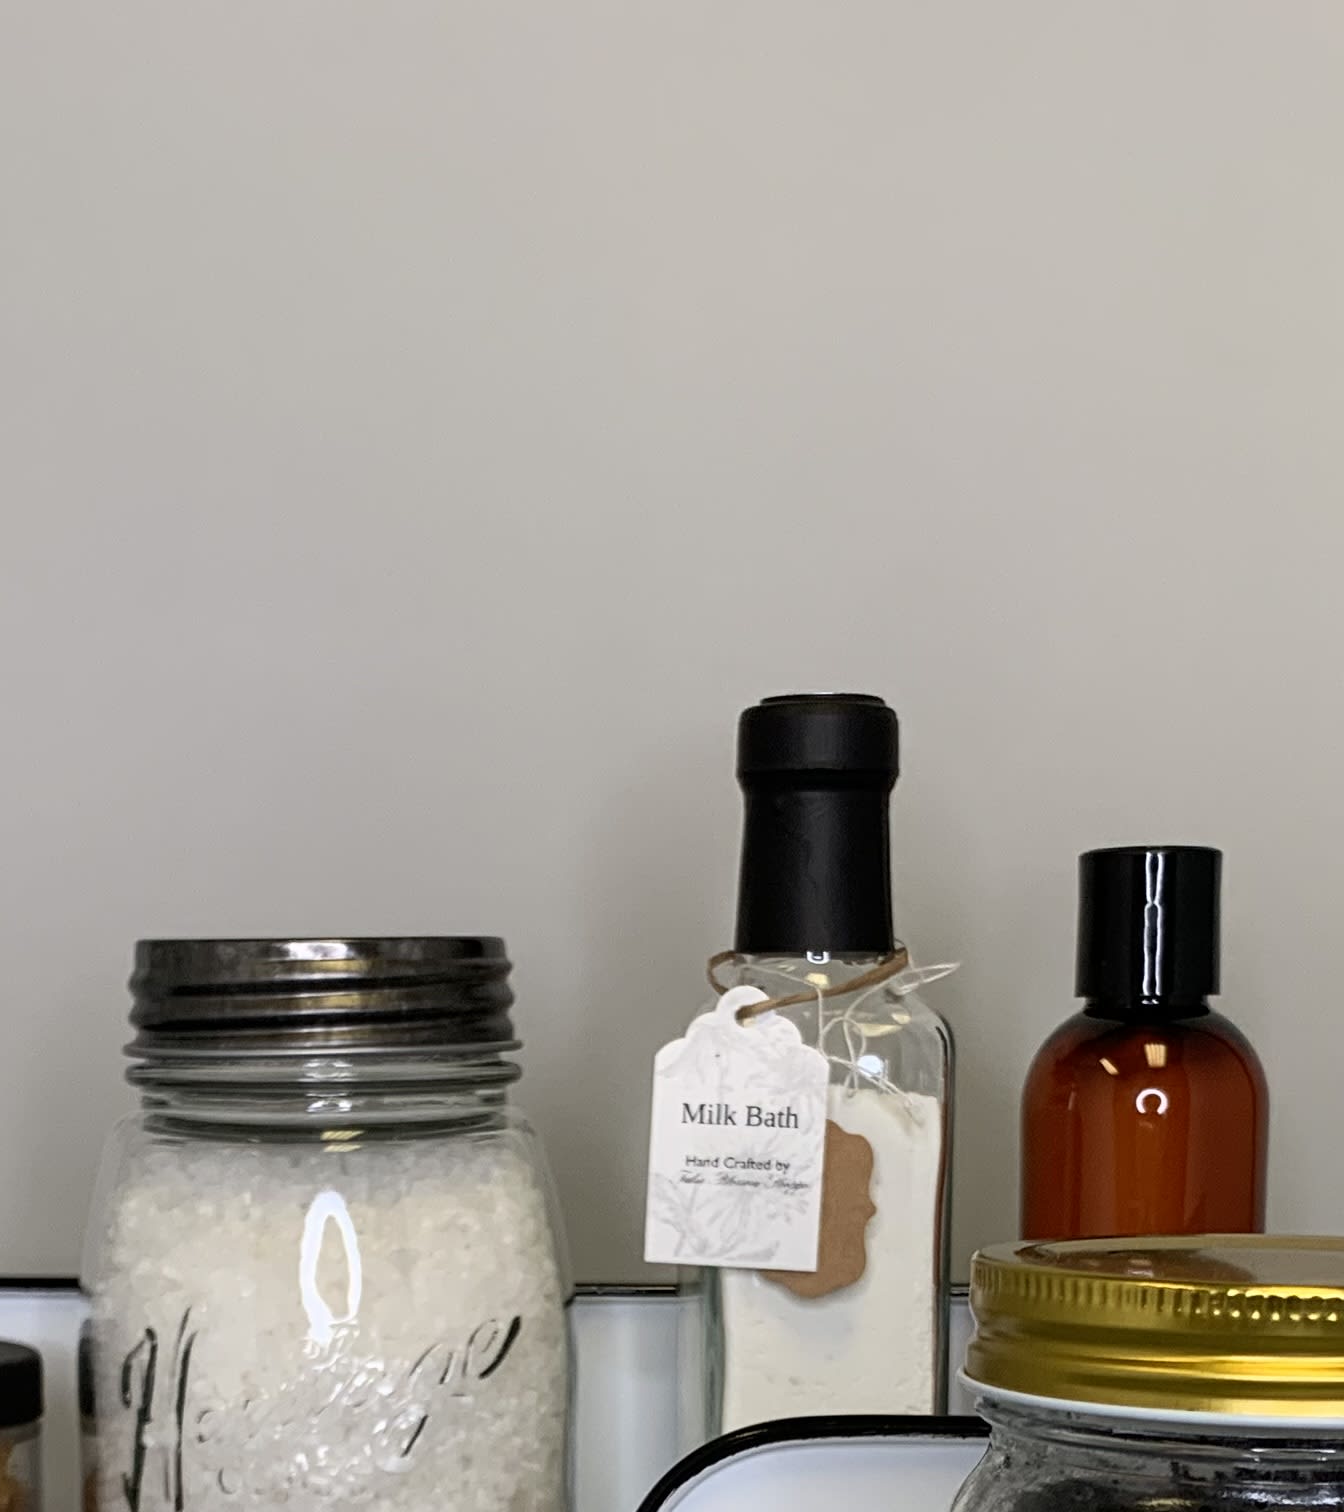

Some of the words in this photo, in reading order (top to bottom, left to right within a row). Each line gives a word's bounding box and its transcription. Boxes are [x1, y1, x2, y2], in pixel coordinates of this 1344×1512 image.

[681, 1102, 737, 1126] Milk
[745, 1105, 799, 1129] Bath
[684, 1155, 719, 1168] Hand
[723, 1156, 771, 1171] Crafted
[775, 1159, 790, 1175] by
